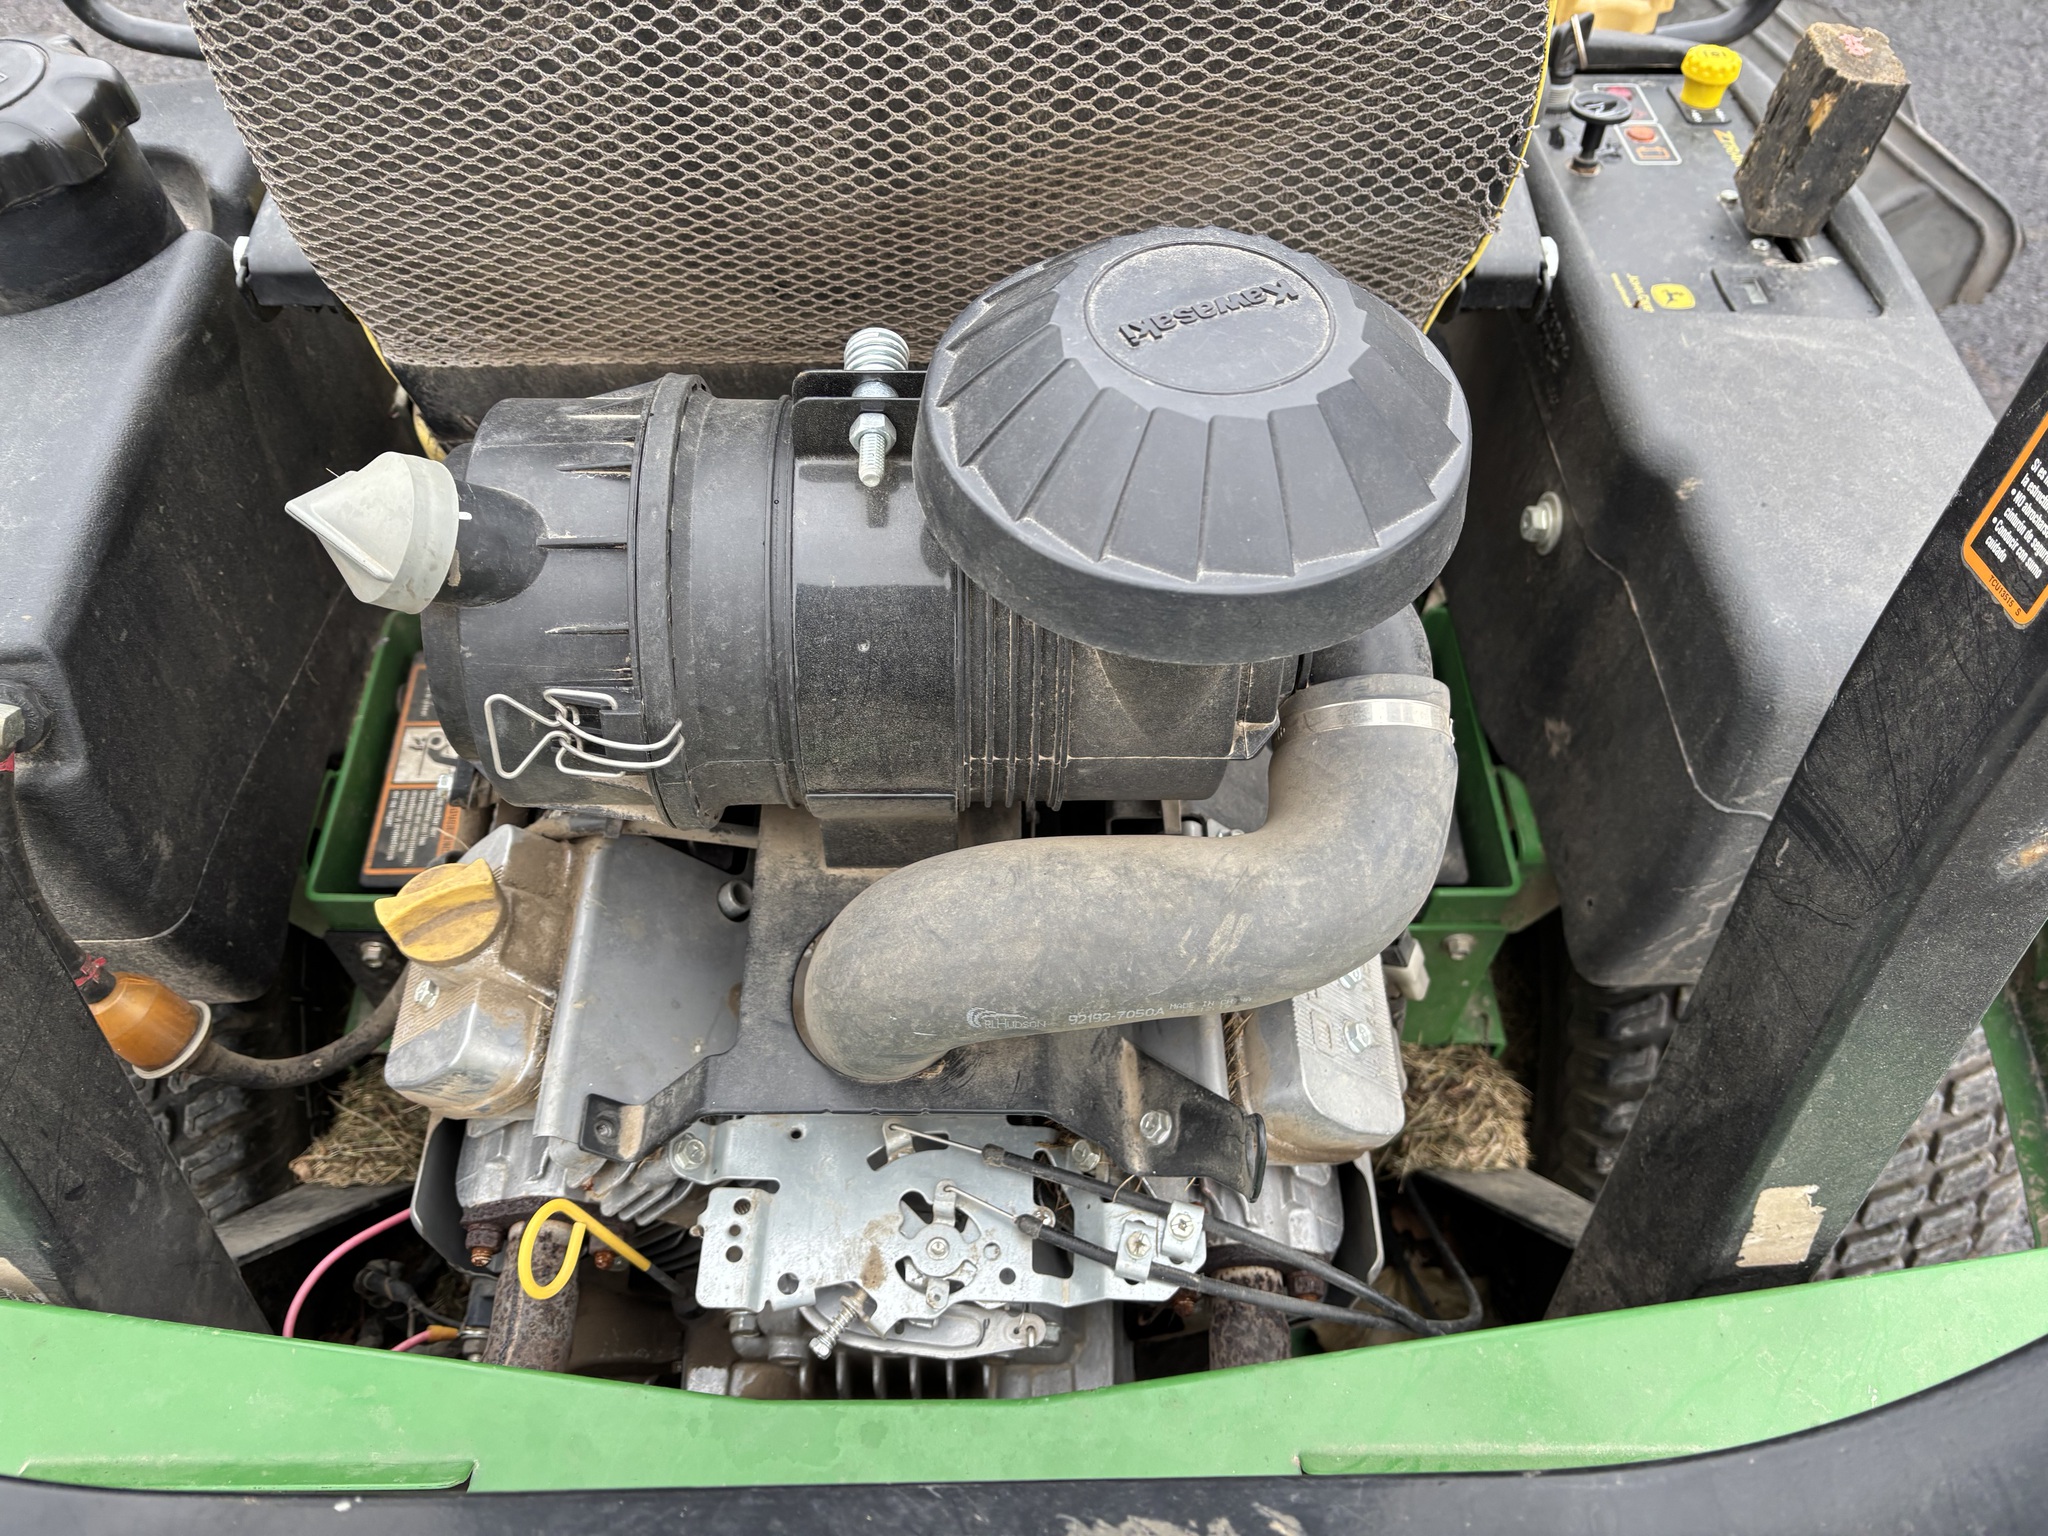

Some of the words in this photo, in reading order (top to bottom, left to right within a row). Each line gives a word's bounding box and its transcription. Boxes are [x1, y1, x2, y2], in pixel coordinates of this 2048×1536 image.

[1119, 279, 1299, 347] Kawasaki
[2030, 458, 2042, 473] Si
[2013, 490, 2026, 508] NO
[2003, 507, 2027, 536] cinturón
[2023, 528, 2034, 544] de
[1985, 535, 2008, 563] cuidado
[1994, 519, 2020, 551] Conducir
[2015, 546, 2029, 563] con
[2024, 557, 2043, 580] sumo
[1988, 575, 2015, 608] TCU13515
[1068, 1007, 1165, 1026] 92192-7050A
[1169, 1001, 1196, 1011] MADE
[1202, 1000, 1215, 1008] IN
[1220, 996, 1252, 1006] CHNA
